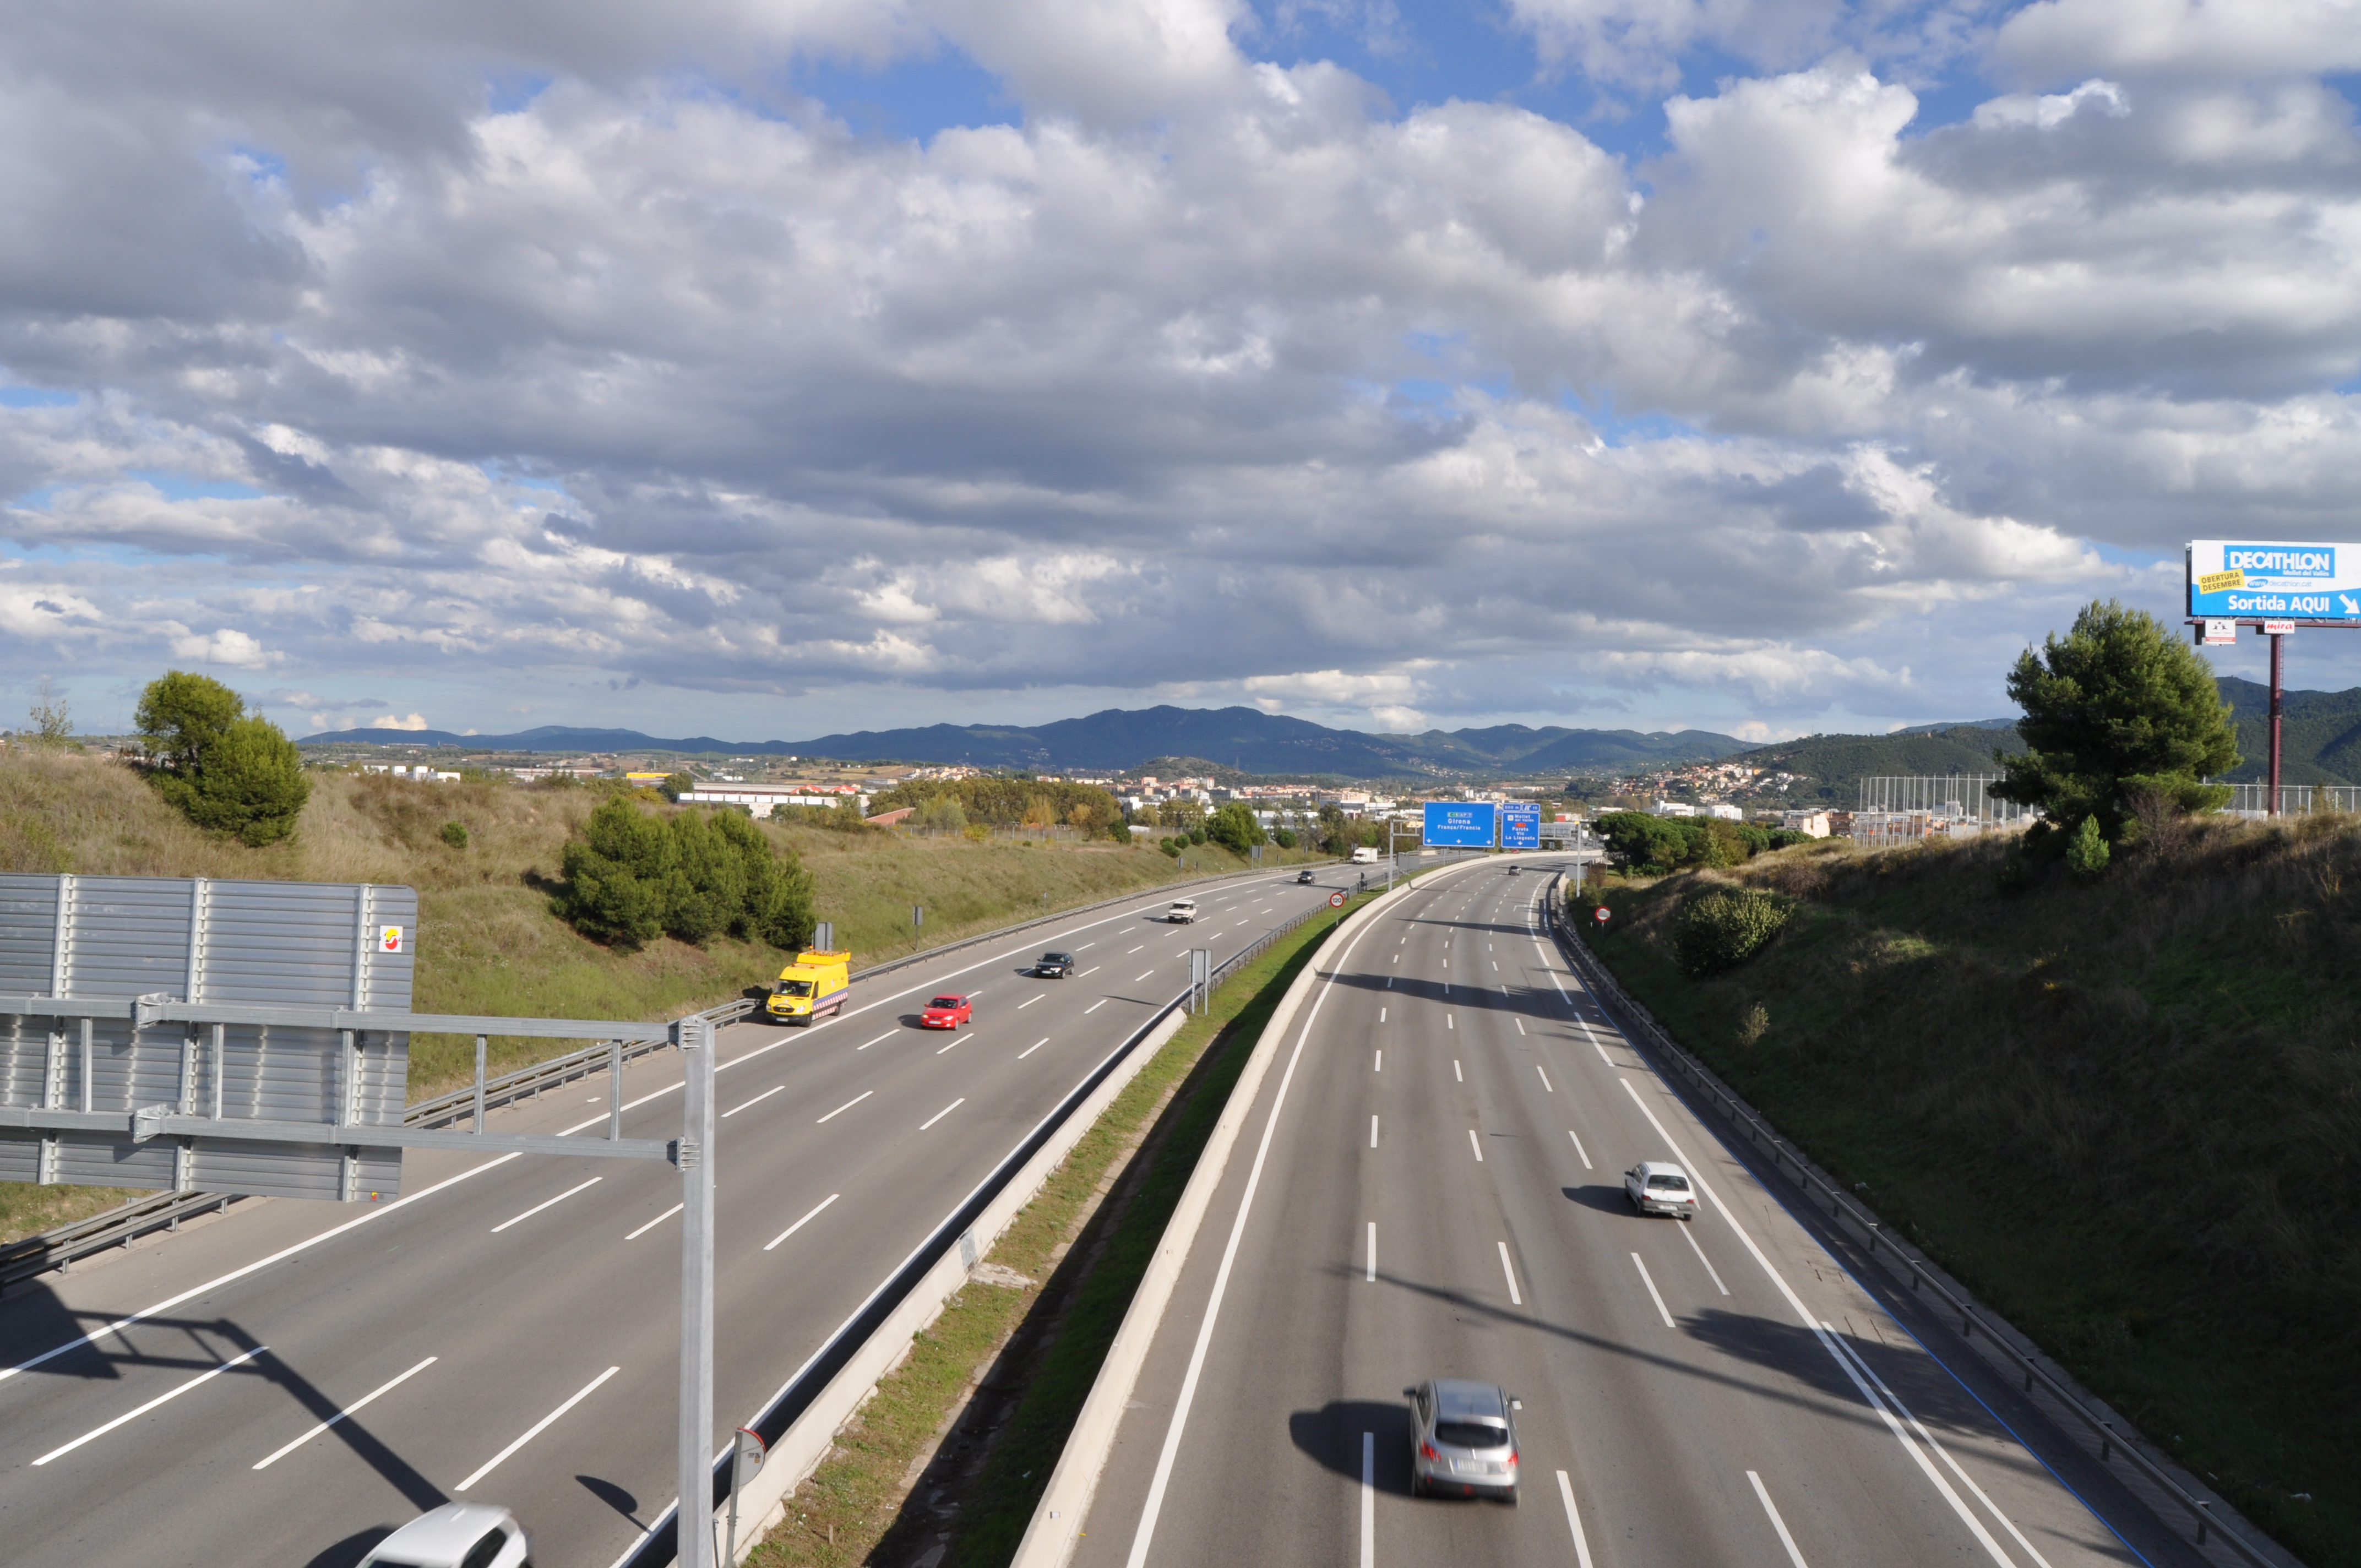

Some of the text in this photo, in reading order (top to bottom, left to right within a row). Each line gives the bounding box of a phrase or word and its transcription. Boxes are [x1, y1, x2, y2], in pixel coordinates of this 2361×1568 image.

[2230, 551, 2330, 570] DECATHLON
[2201, 572, 2239, 584] OBERTURA
[2203, 579, 2240, 591] DESEMBRE
[2228, 595, 2330, 614] Sortida AQUI
